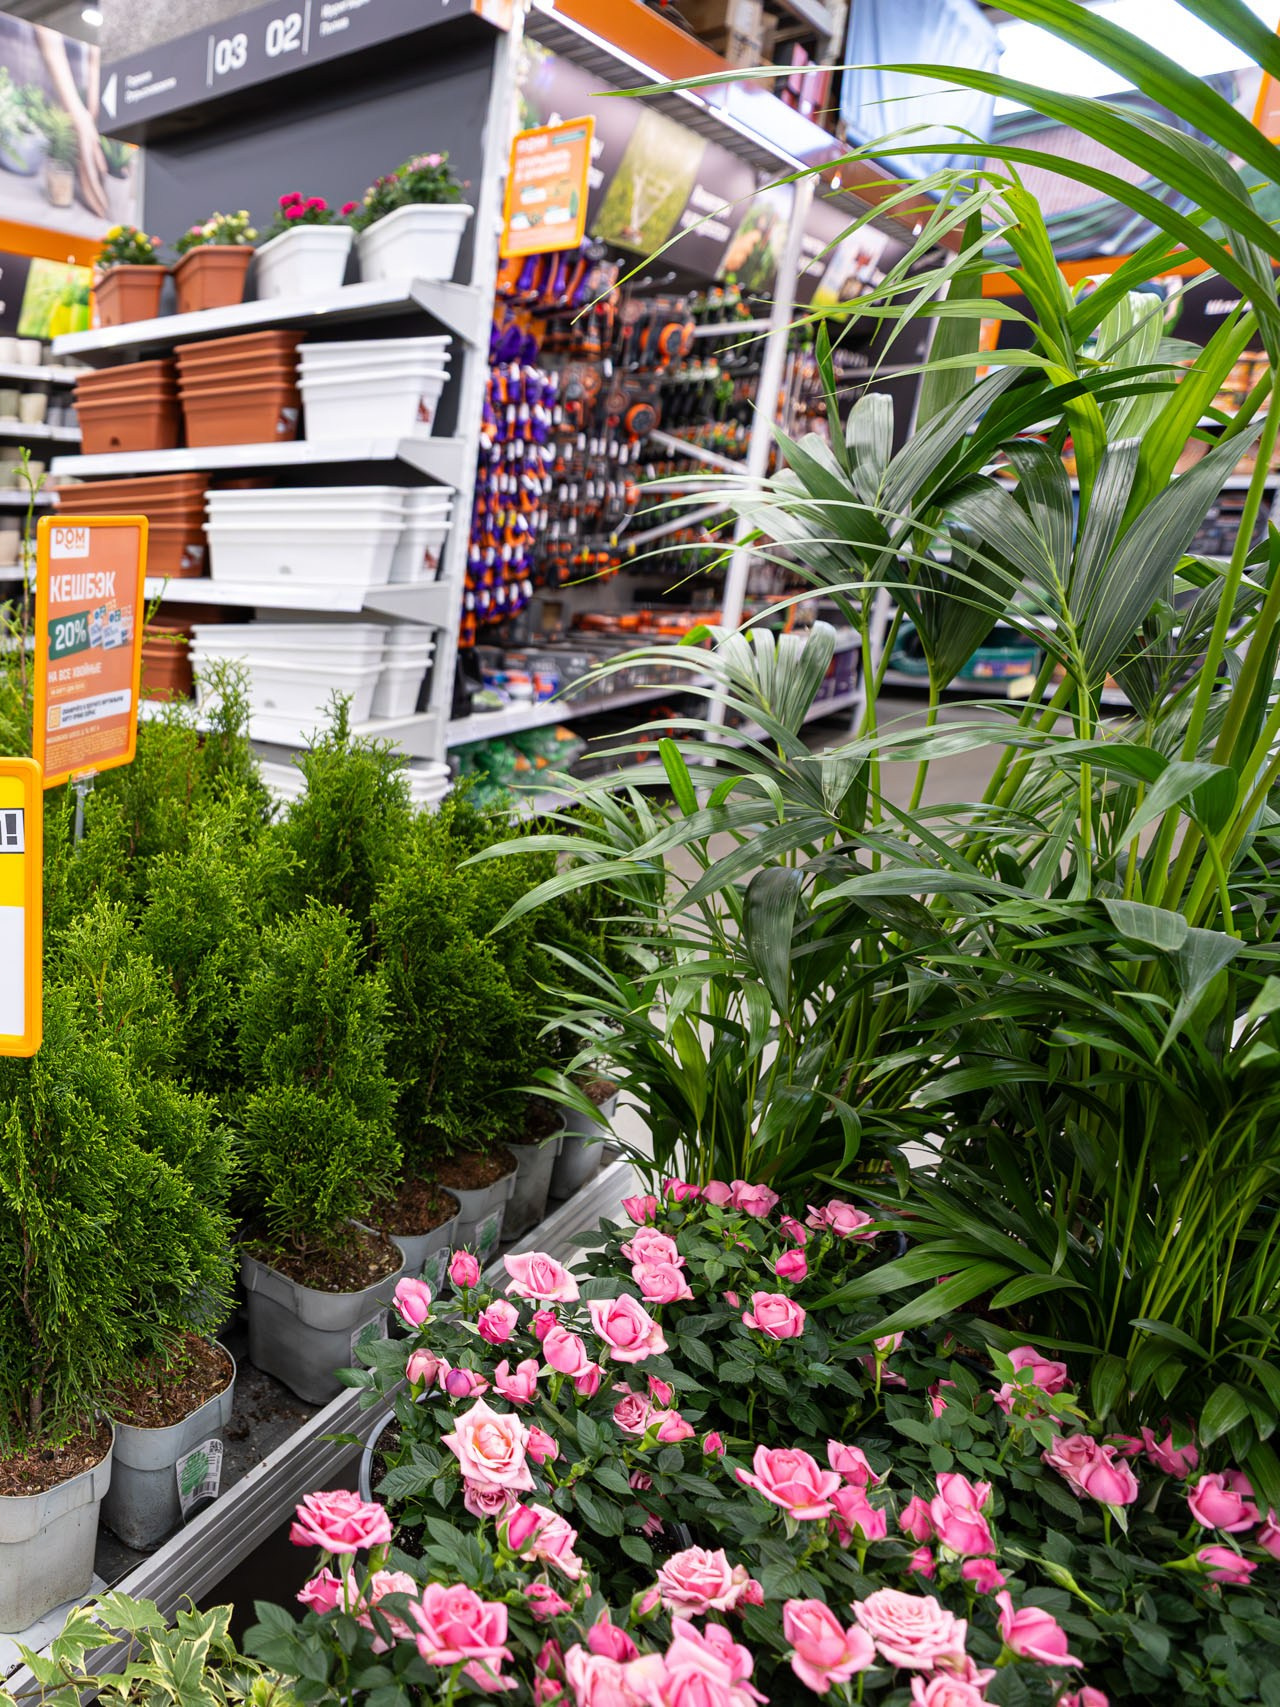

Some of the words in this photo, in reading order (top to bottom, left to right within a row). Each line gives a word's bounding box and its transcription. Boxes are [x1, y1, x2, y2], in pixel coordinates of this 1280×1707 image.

[215, 33, 248, 74] 03
[265, 13, 302, 57] 02
[50, 571, 116, 603] КЕШБЭК
[55, 617, 87, 651] 20%
